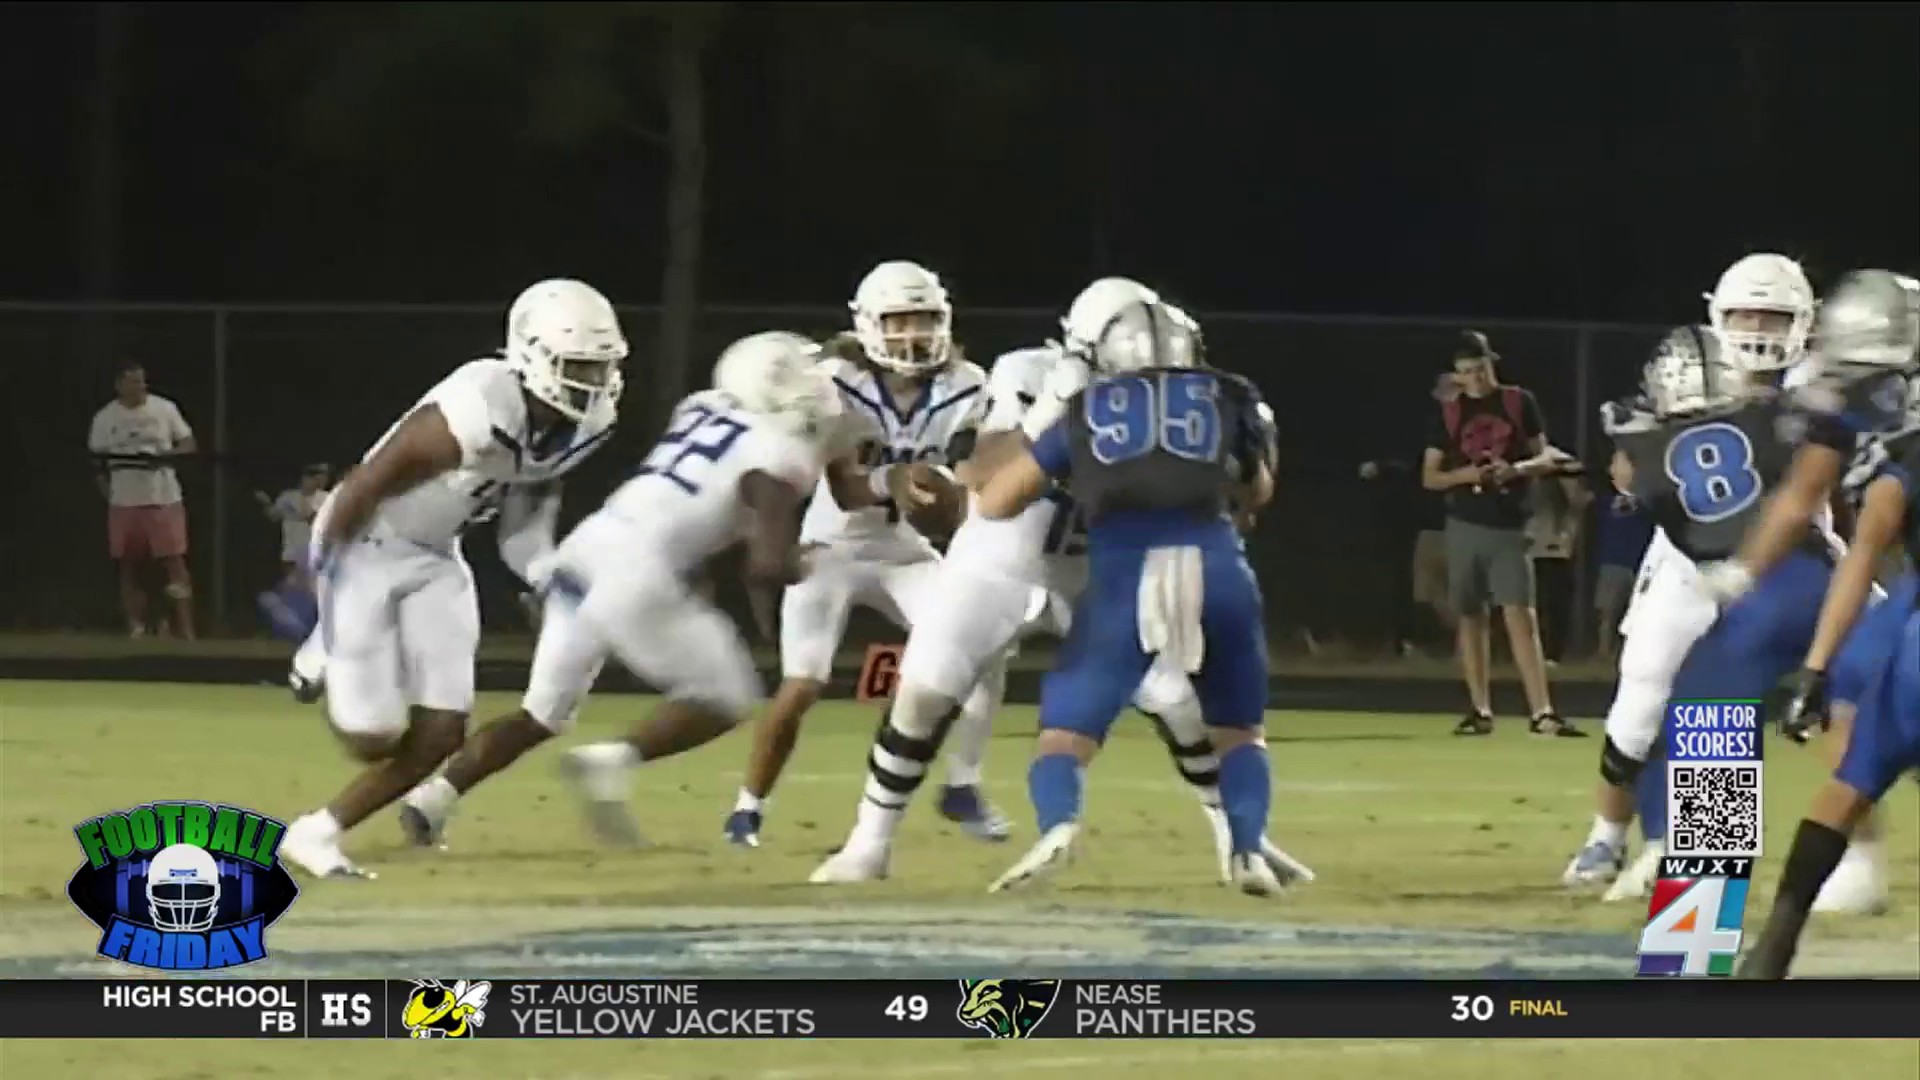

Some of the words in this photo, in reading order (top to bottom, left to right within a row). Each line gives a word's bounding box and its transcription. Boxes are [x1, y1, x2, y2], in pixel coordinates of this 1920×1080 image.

[636, 404, 749, 495] 22
[1085, 373, 1221, 465] 95
[1664, 422, 1761, 522] 8
